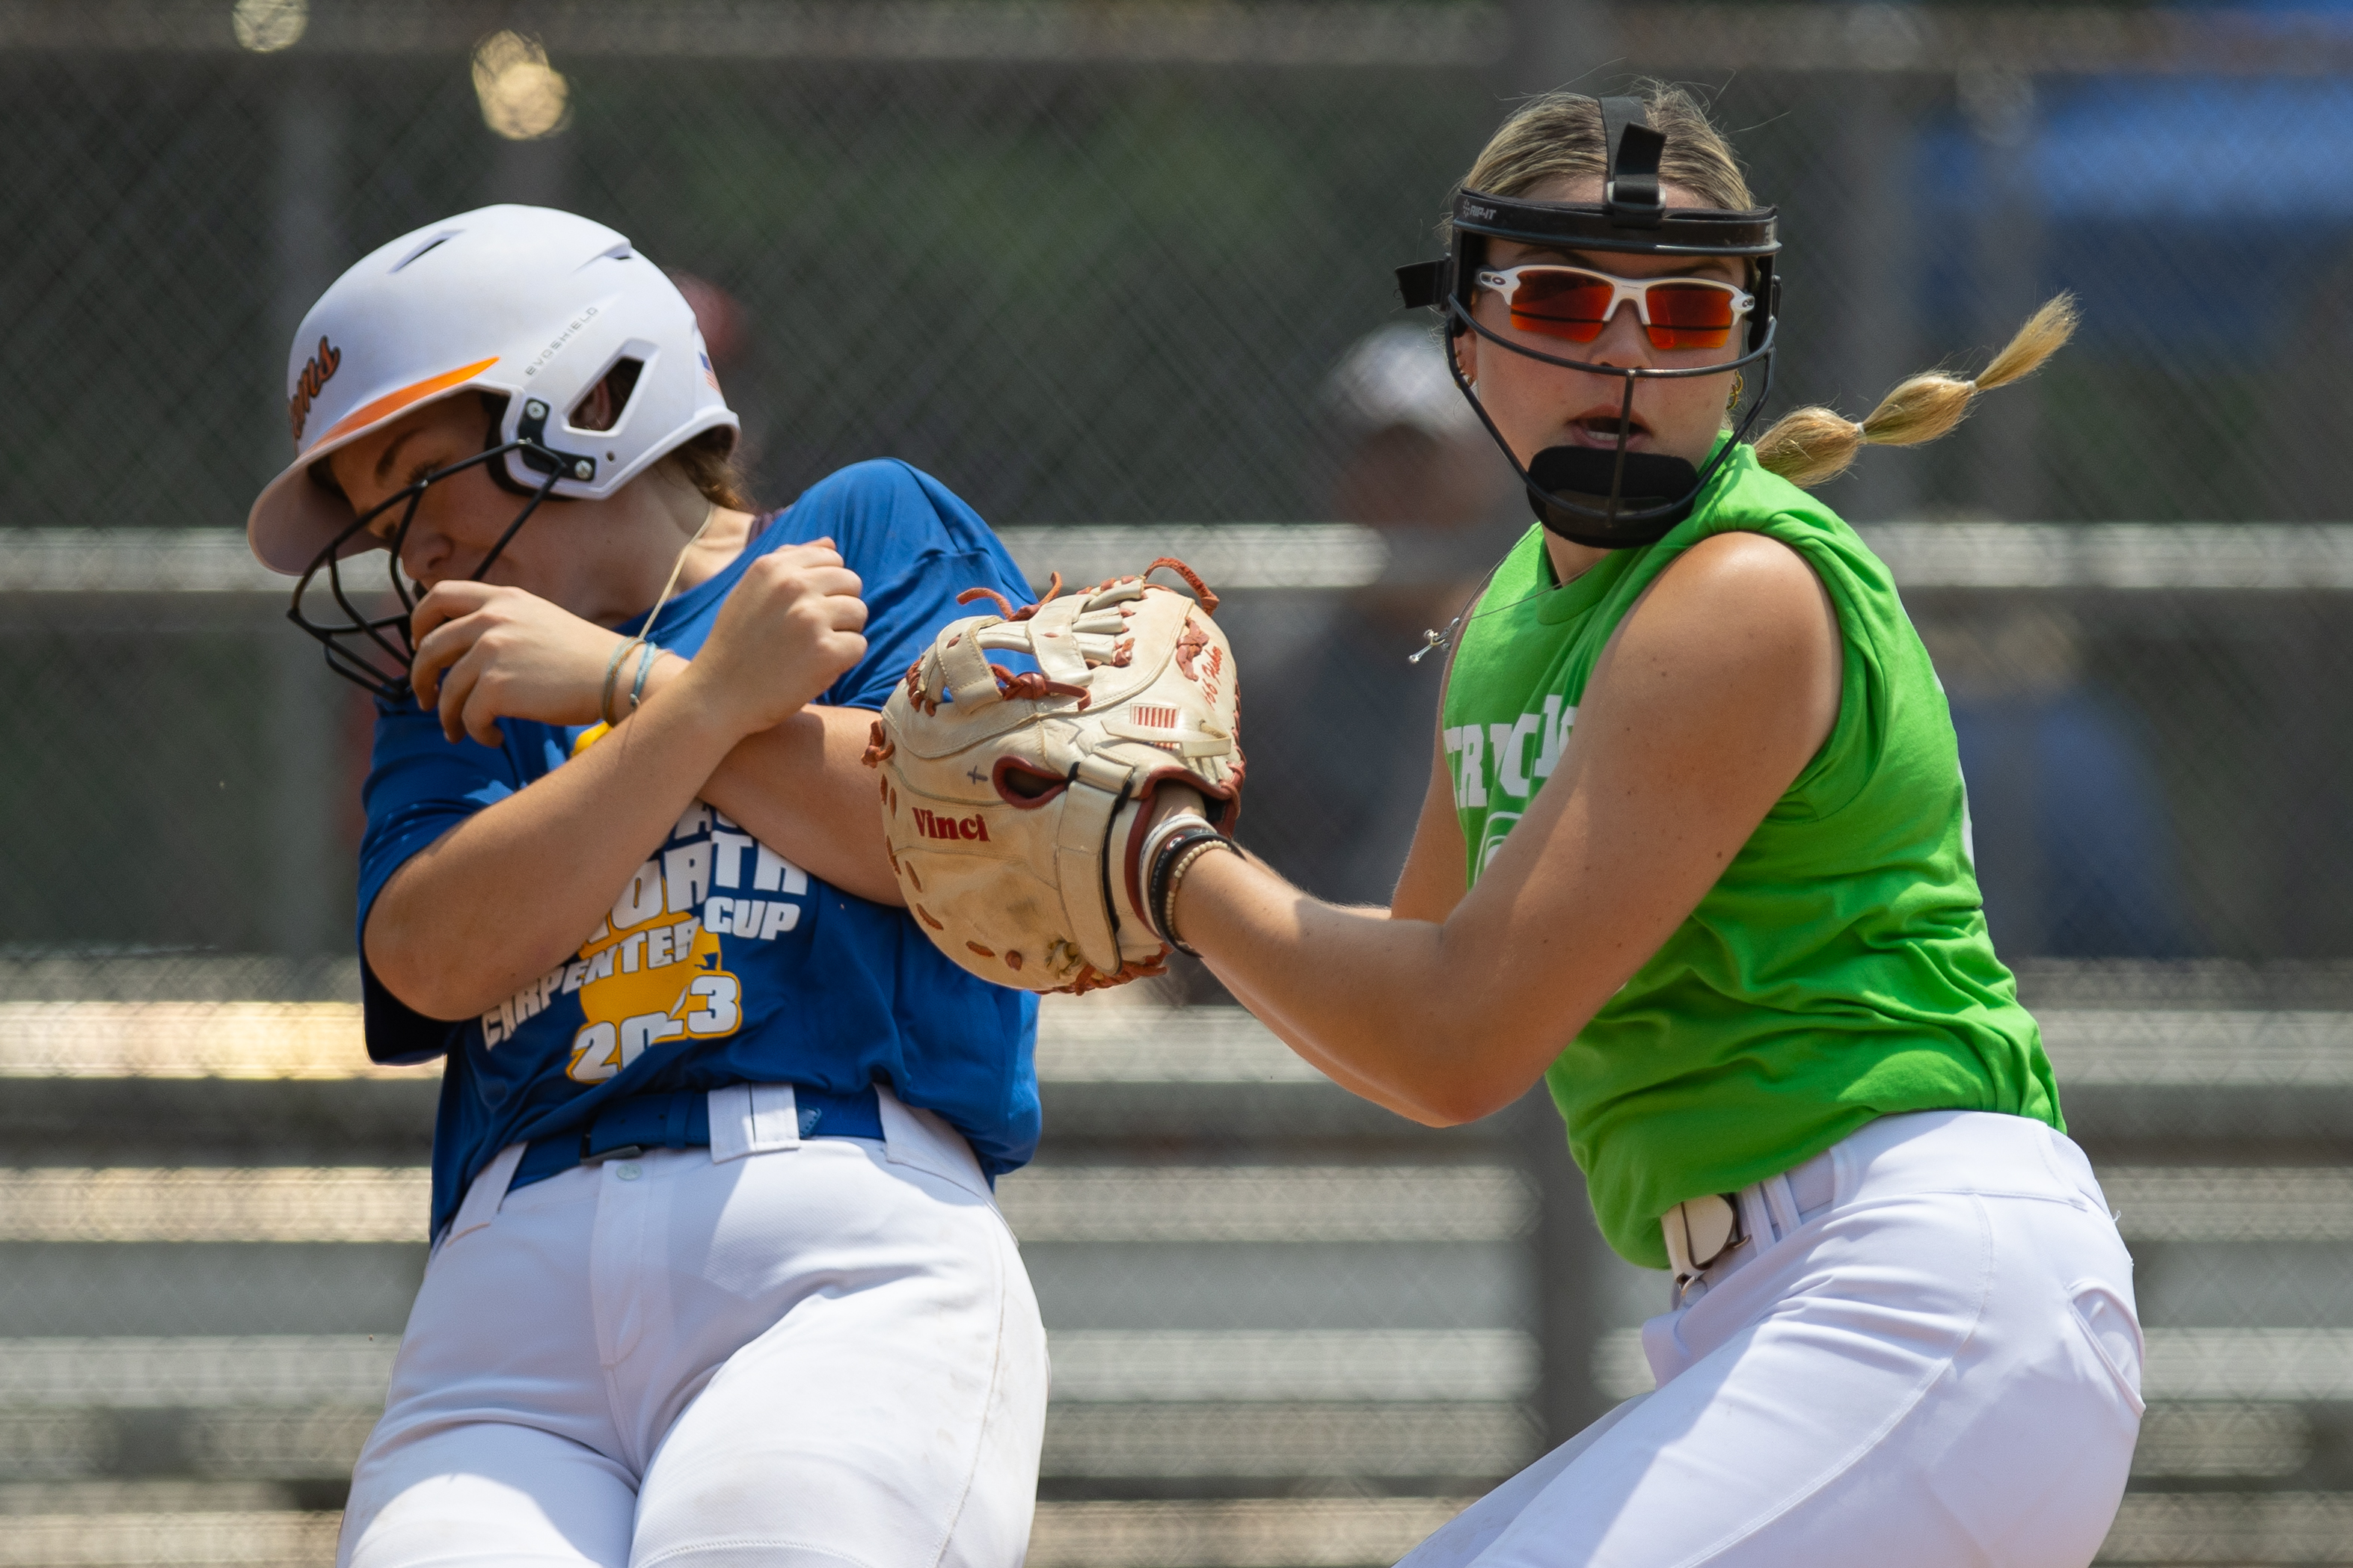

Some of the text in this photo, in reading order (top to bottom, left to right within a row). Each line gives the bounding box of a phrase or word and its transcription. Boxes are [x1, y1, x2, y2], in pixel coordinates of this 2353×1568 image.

[912, 807, 990, 842] Vinci
[588, 830, 809, 944] ORTH
[482, 896, 801, 1052] CARPENTER CUP
